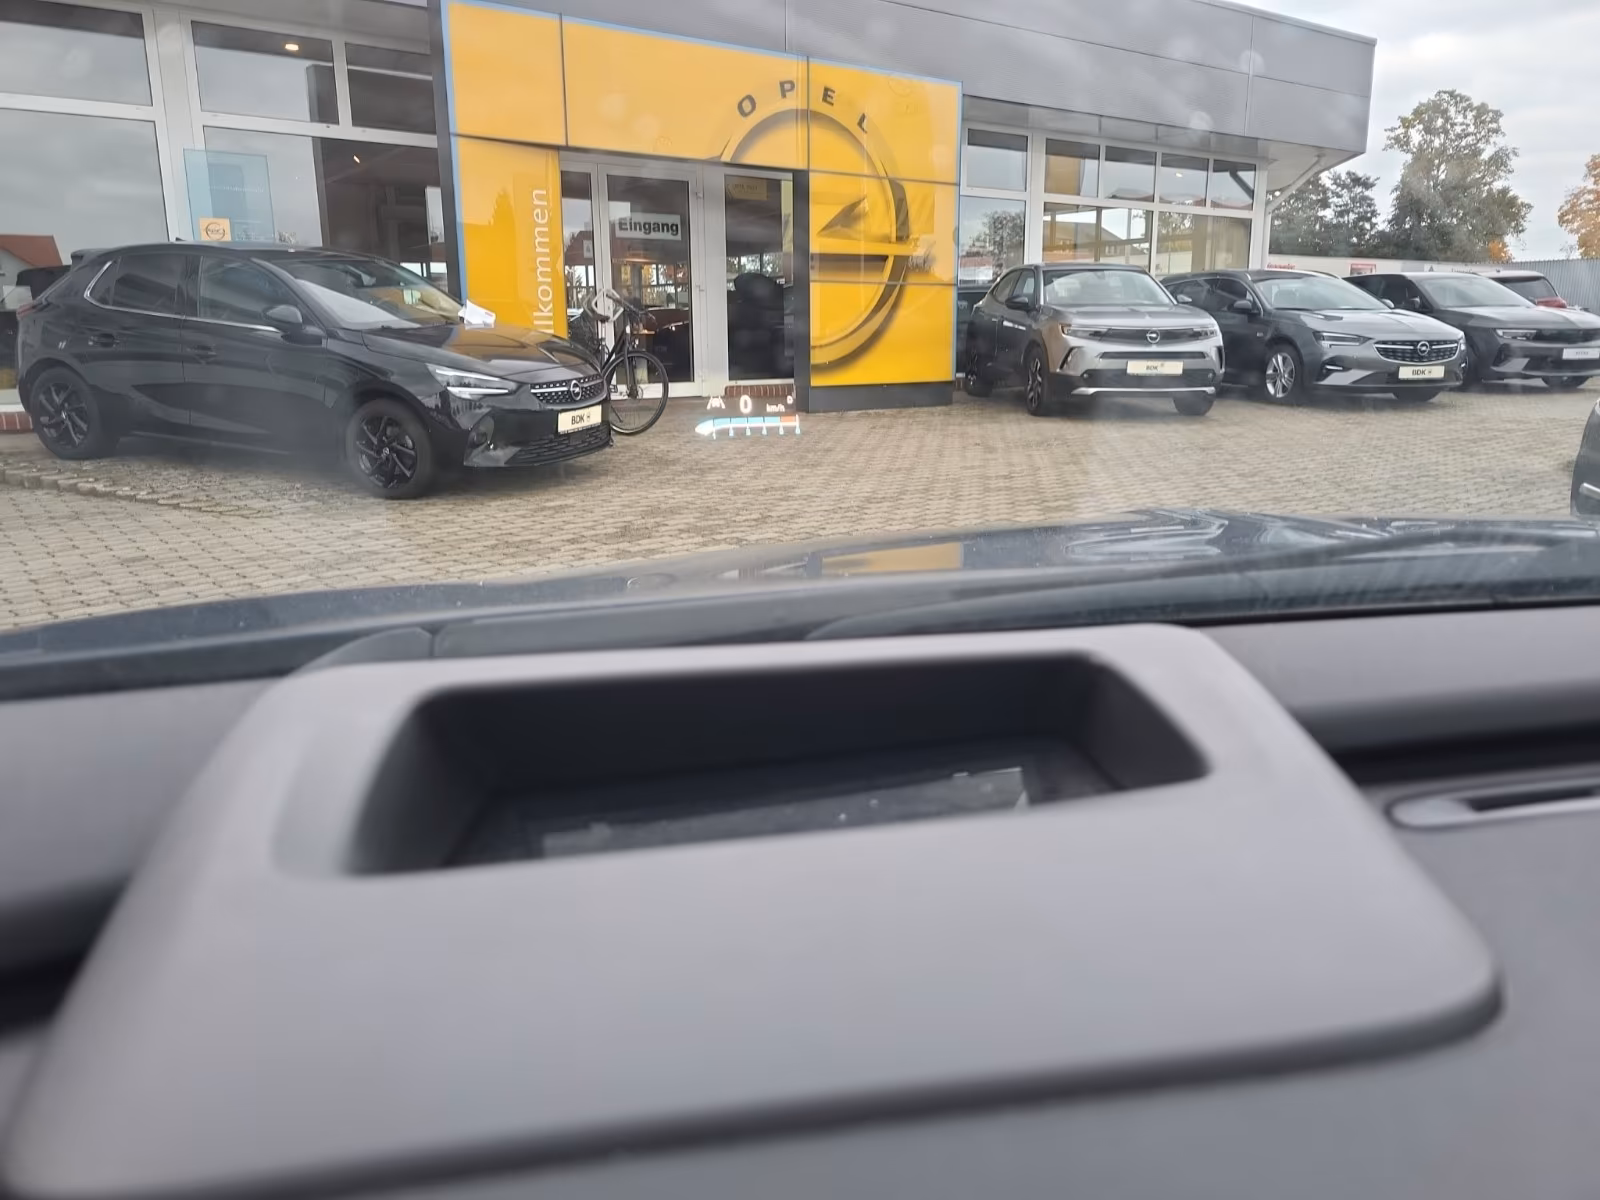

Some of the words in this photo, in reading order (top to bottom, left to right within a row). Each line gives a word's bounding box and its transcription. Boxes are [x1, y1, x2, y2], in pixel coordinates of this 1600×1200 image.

[737, 79, 868, 134] OPEL
[618, 217, 679, 236] Eingang
[1411, 368, 1427, 376] BDK
[739, 394, 753, 413] 0
[766, 403, 785, 413] km/h
[571, 414, 585, 425] BDK
